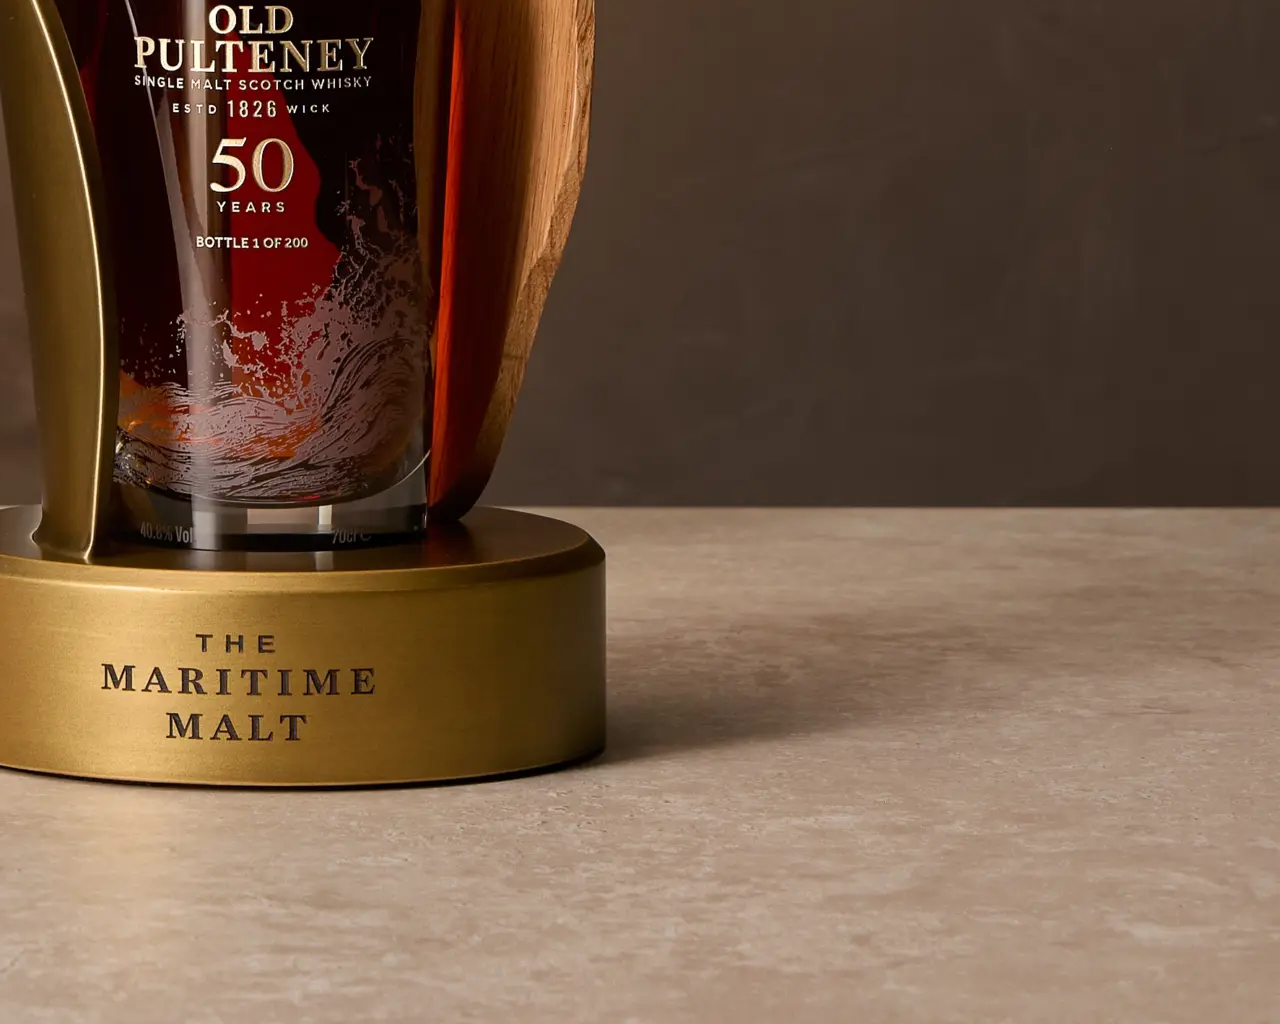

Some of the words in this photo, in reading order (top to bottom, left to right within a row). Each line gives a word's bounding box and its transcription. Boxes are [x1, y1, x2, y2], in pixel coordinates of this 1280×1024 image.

[208, 4, 294, 35] OLD
[133, 36, 374, 73] PULTENEY
[134, 75, 184, 89] SINGLE
[191, 78, 232, 91] MALT
[238, 79, 305, 91] SCOTCH
[311, 75, 373, 90] WHISKY
[172, 103, 217, 115] ESTD
[227, 99, 277, 118] 1826
[286, 103, 331, 114] WICK
[209, 136, 295, 193] 50
[216, 201, 285, 213] YEARS
[196, 236, 249, 249] BOTTLE
[252, 237, 260, 249] 1
[263, 237, 282, 249] OF
[285, 237, 309, 249] 200
[195, 633, 276, 654] THE
[101, 663, 376, 696] MARITIME
[166, 712, 308, 741] MALT
